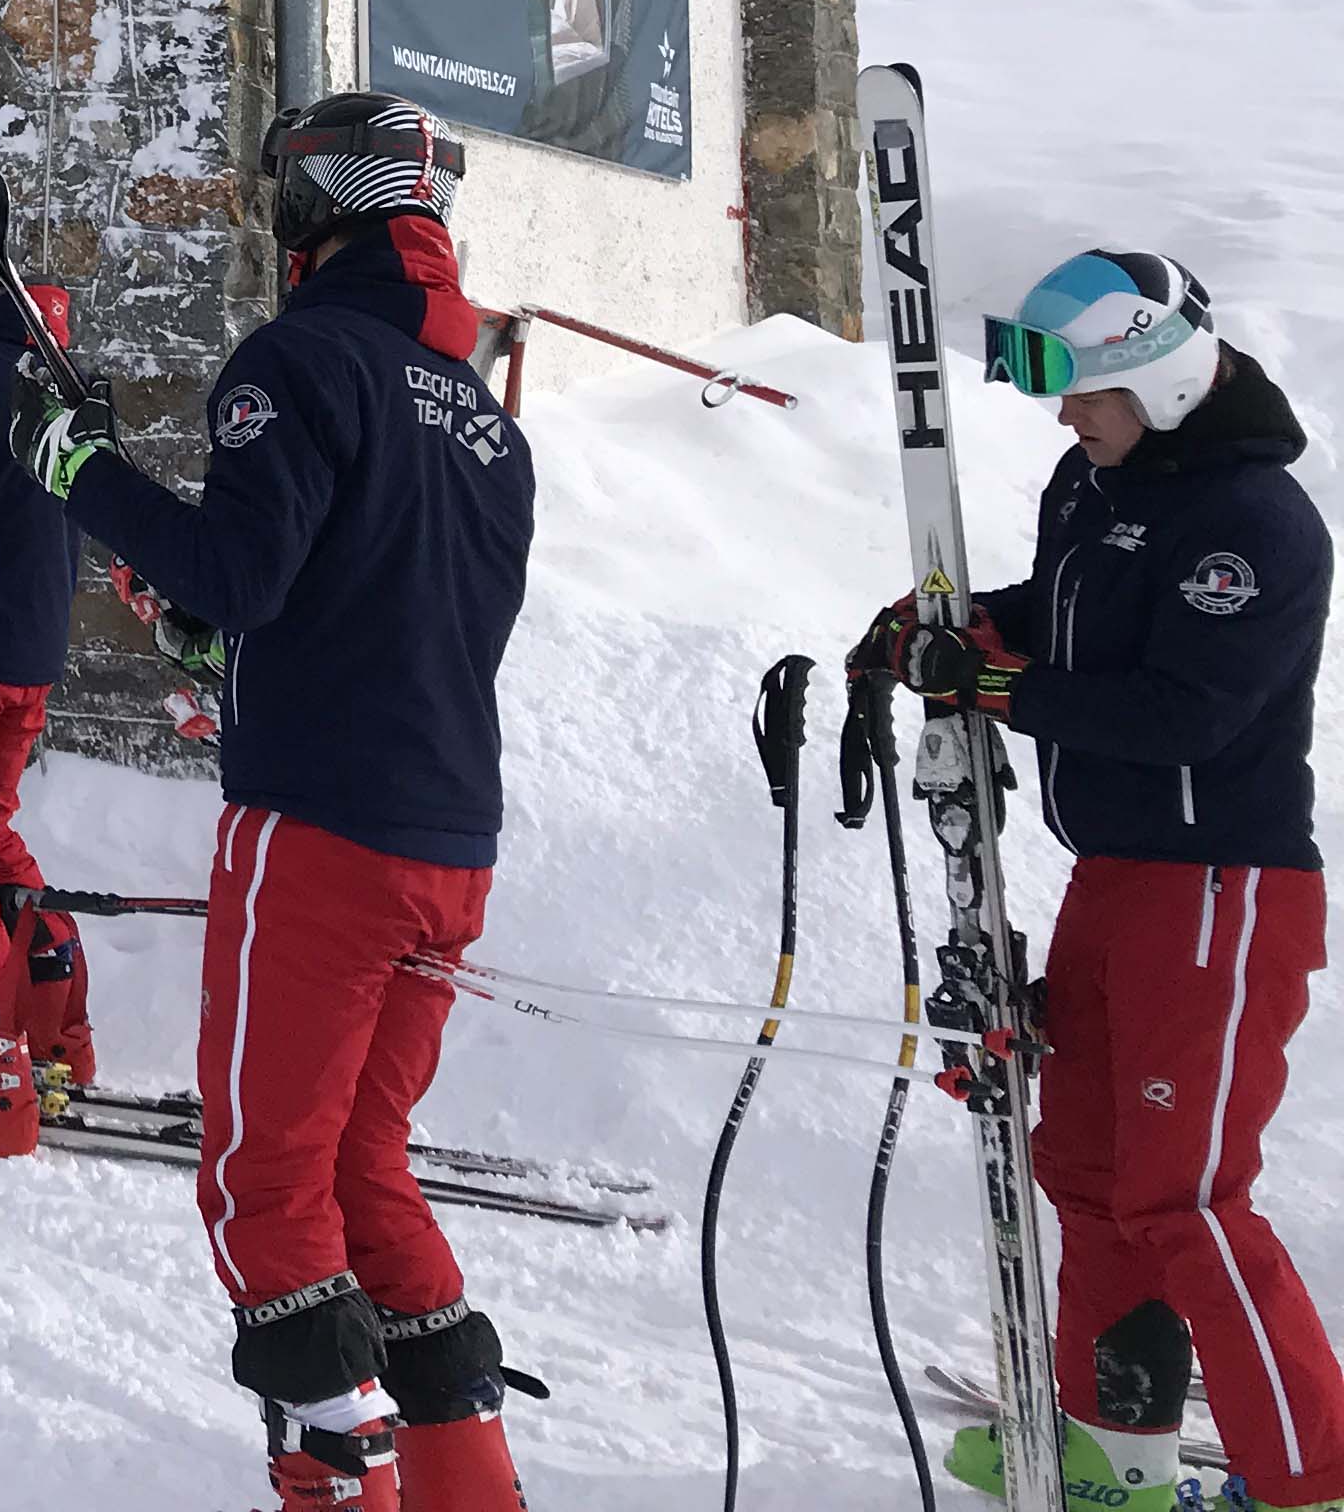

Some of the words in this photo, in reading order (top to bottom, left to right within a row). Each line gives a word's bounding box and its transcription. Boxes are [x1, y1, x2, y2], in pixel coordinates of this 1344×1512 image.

[392, 45, 517, 97] MOUNTAINHOTELS.CH
[646, 100, 683, 133] HOTELS
[873, 124, 947, 449] HEAD
[876, 1089, 907, 1177] SCOTT
[254, 1278, 337, 1323] QUIET
[426, 1300, 472, 1331] QUIE
